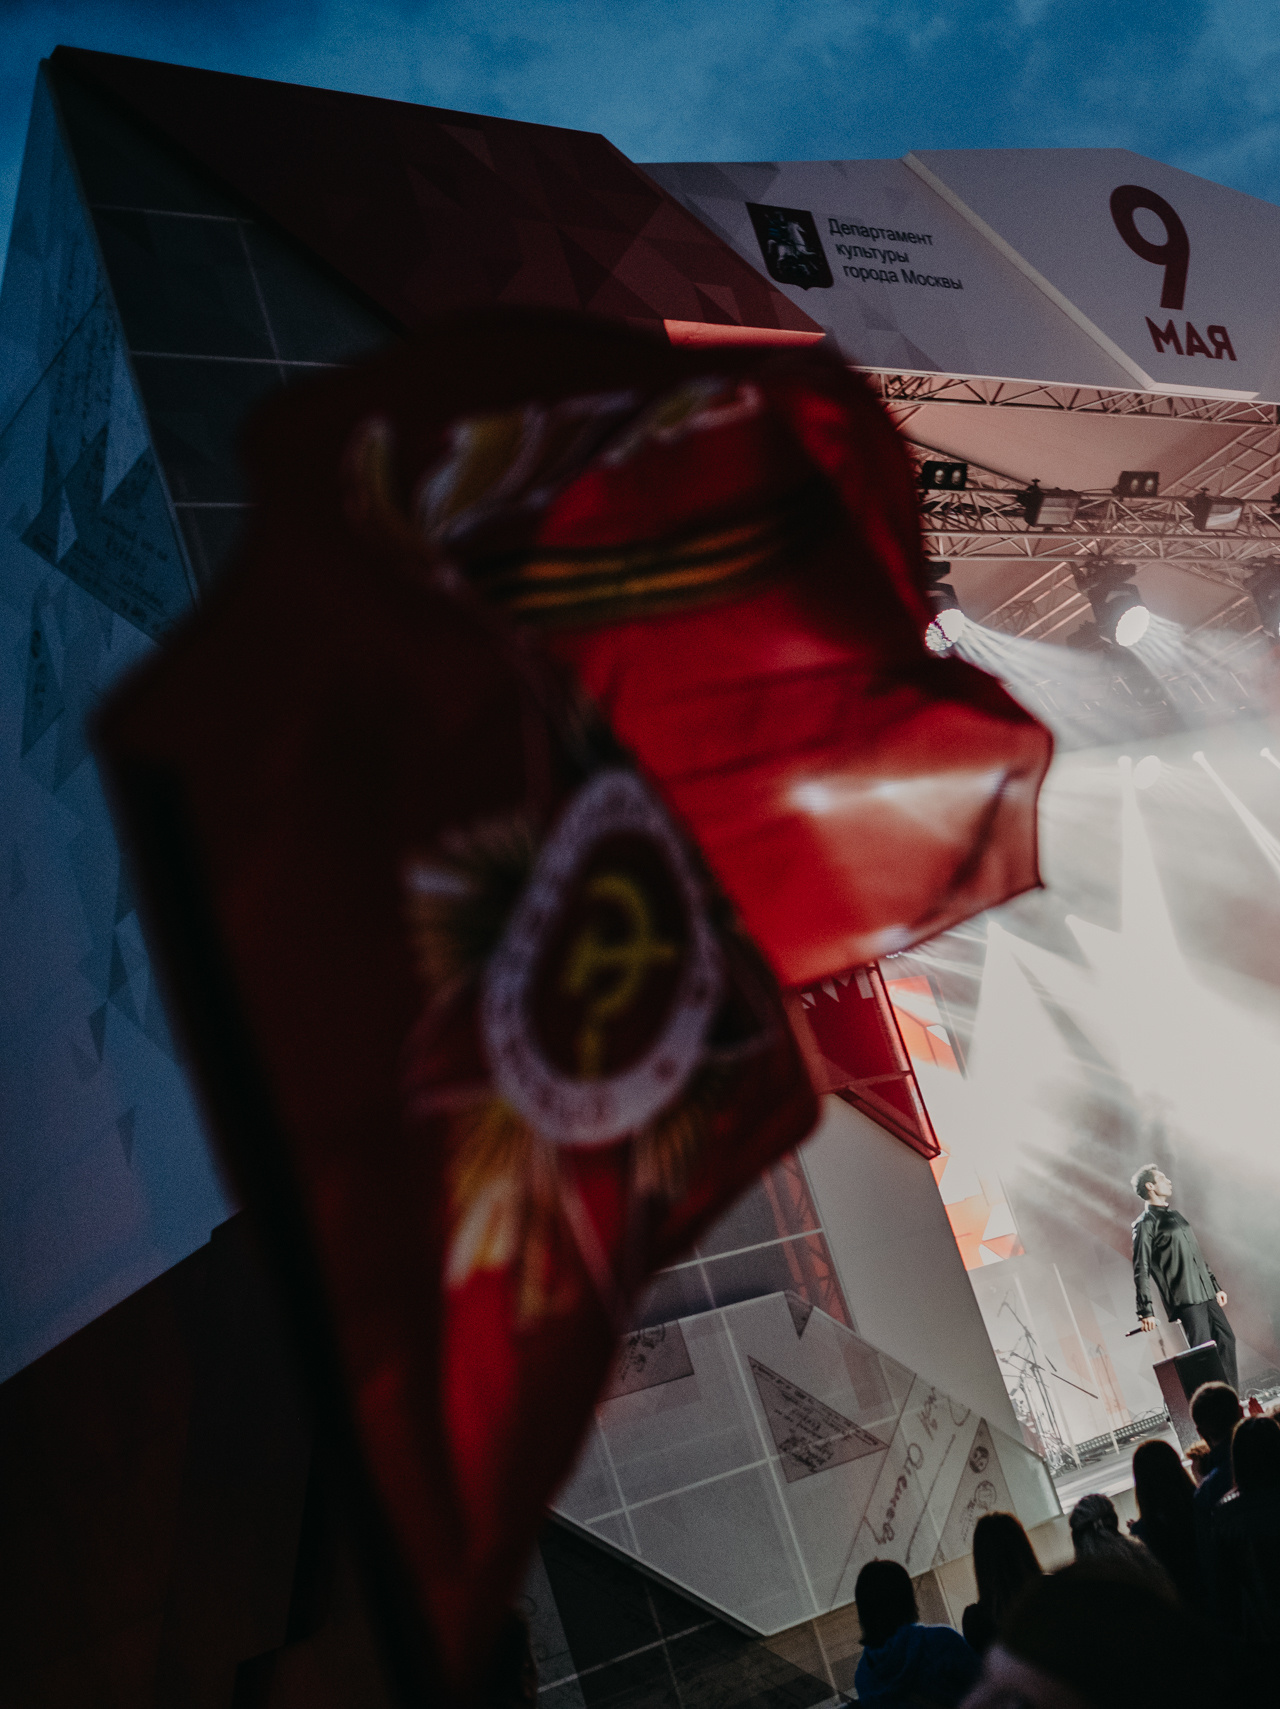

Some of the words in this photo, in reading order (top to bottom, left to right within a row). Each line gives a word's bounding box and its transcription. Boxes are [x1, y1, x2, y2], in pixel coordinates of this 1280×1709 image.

[827, 217, 934, 246] Департамент
[835, 243, 910, 265] культуры
[1109, 184, 1190, 311] 9
[842, 264, 899, 284] города
[900, 268, 964, 290] Москвы
[1144, 315, 1238, 362] МАЯ
